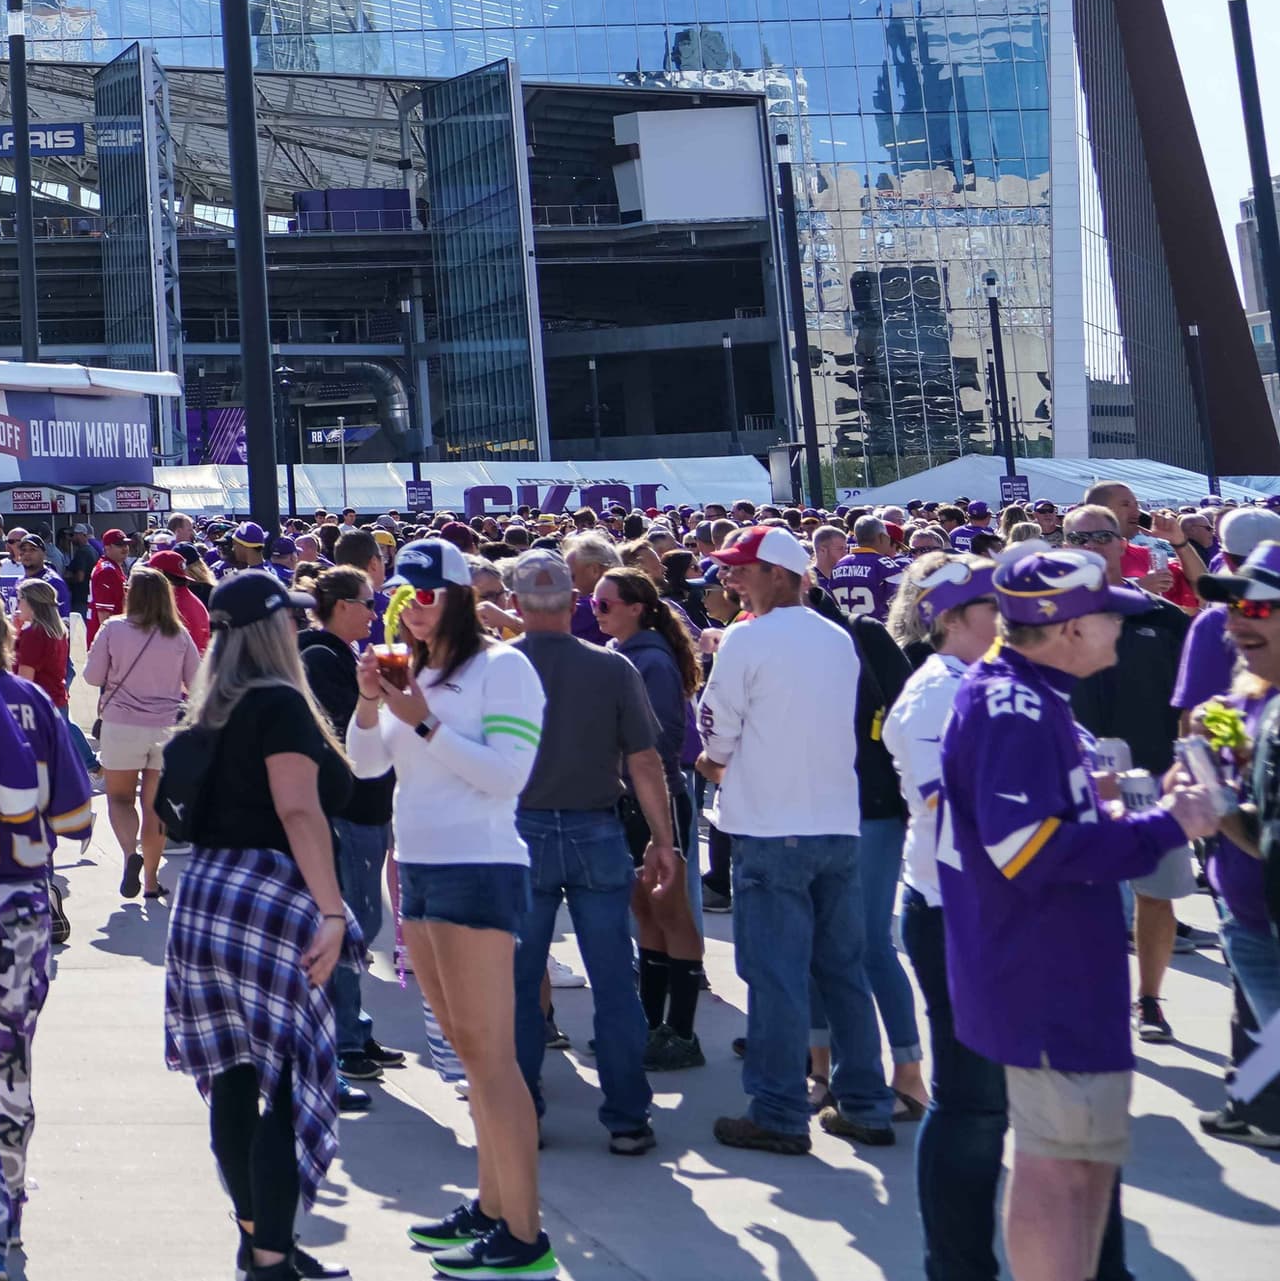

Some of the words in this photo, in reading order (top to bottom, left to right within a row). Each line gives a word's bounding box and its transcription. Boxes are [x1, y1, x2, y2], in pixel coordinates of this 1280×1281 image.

[29, 419, 81, 457] BLOODY
[85, 422, 120, 458] MARY
[123, 423, 149, 458] BAR
[13, 491, 42, 501] SMIRNOFF
[985, 683, 1041, 721] 22
